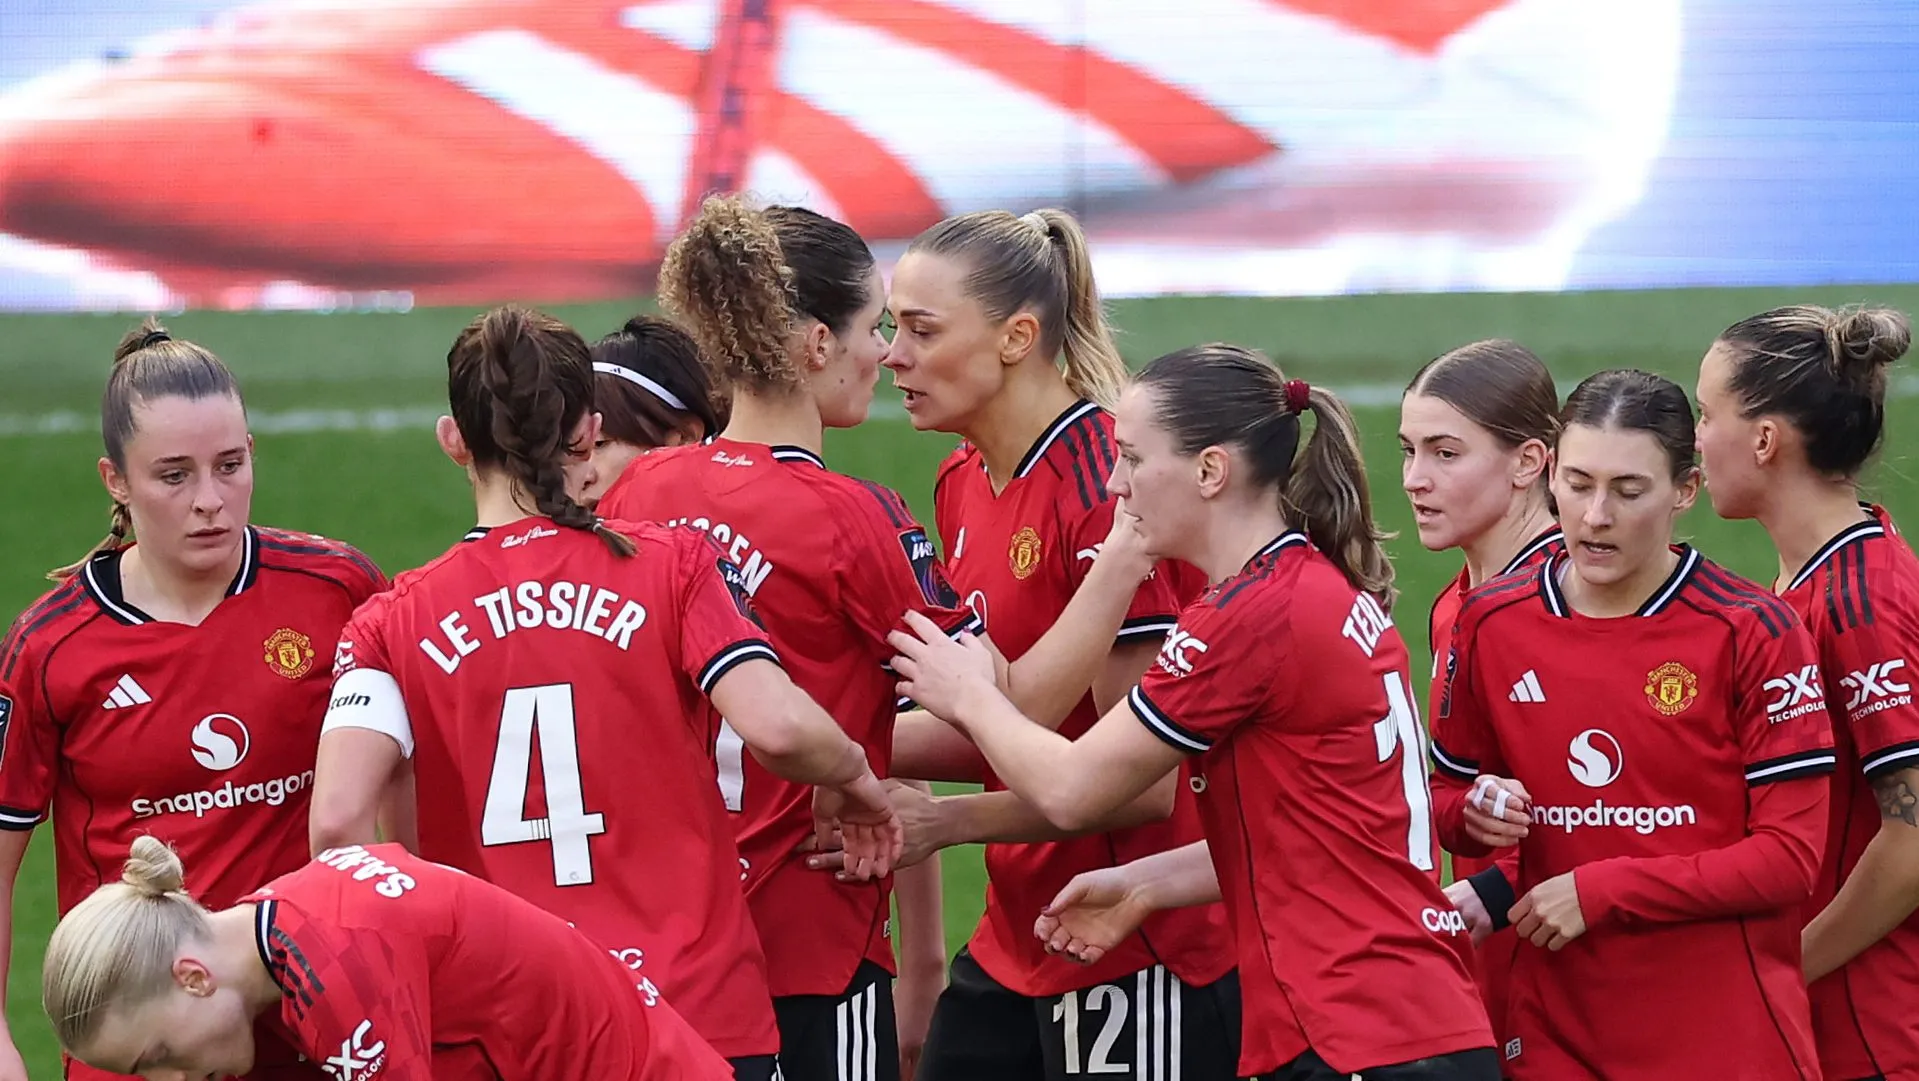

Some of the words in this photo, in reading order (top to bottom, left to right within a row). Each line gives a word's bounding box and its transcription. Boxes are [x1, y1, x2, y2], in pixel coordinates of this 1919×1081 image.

[420, 611, 481, 675] LE
[475, 581, 646, 651] TISSIER
[1342, 590, 1395, 658] TERL
[1162, 623, 1208, 673] XC
[278, 664, 307, 676] UNITED
[1651, 666, 1693, 685] MANCHESTER
[1839, 659, 1911, 711] DXC
[1655, 702, 1686, 712] UNITED
[1768, 701, 1826, 724] TECHNOLOG
[1852, 695, 1912, 722] TECHNOLOGY
[131, 769, 315, 819] Snapdragon
[480, 683, 606, 886] 4
[1530, 800, 1696, 835] napdragon
[1421, 907, 1467, 936] Cop
[1053, 984, 1129, 1074] 12
